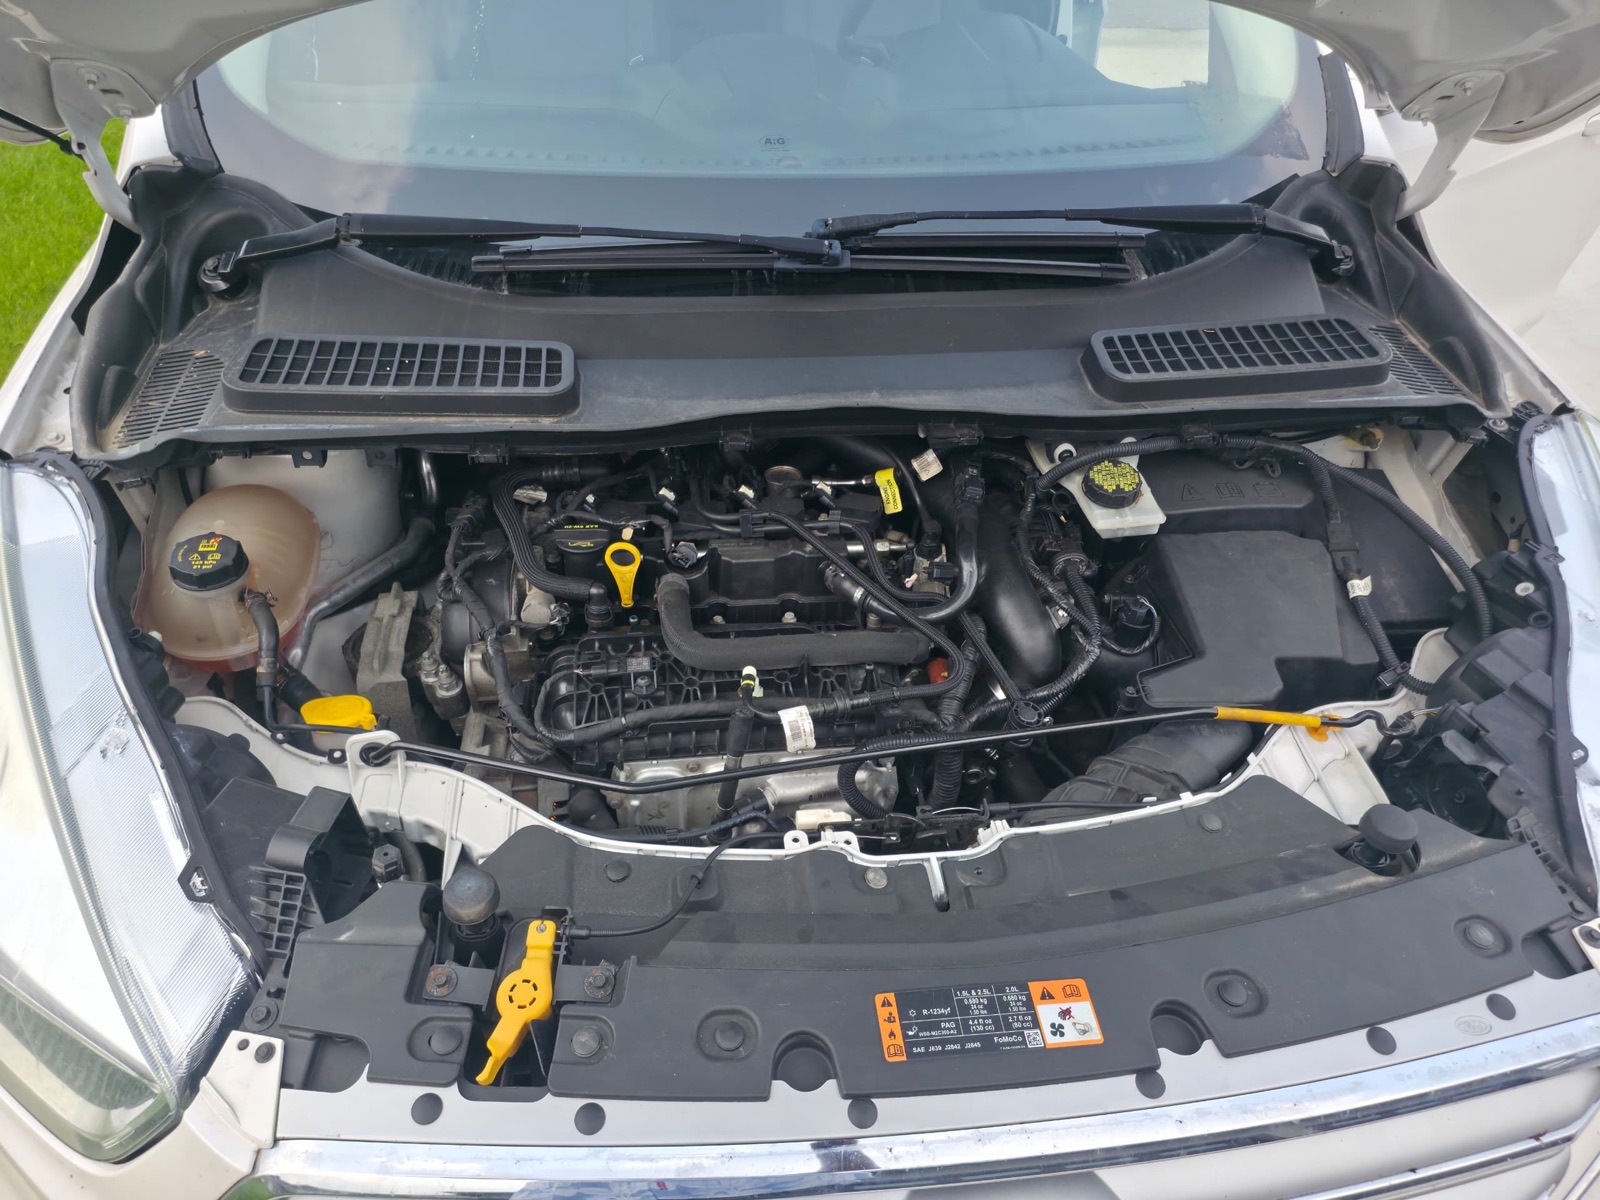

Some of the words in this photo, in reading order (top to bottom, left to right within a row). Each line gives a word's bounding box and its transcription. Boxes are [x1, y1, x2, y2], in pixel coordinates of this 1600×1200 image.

[882, 487, 891, 505] ENGINE
[977, 988, 991, 996] 2.5L
[979, 997, 988, 1005] kg
[1018, 994, 1027, 1002] kg
[922, 1007, 951, 1016] R-1234yf
[993, 1035, 1023, 1043] FoMoCo
